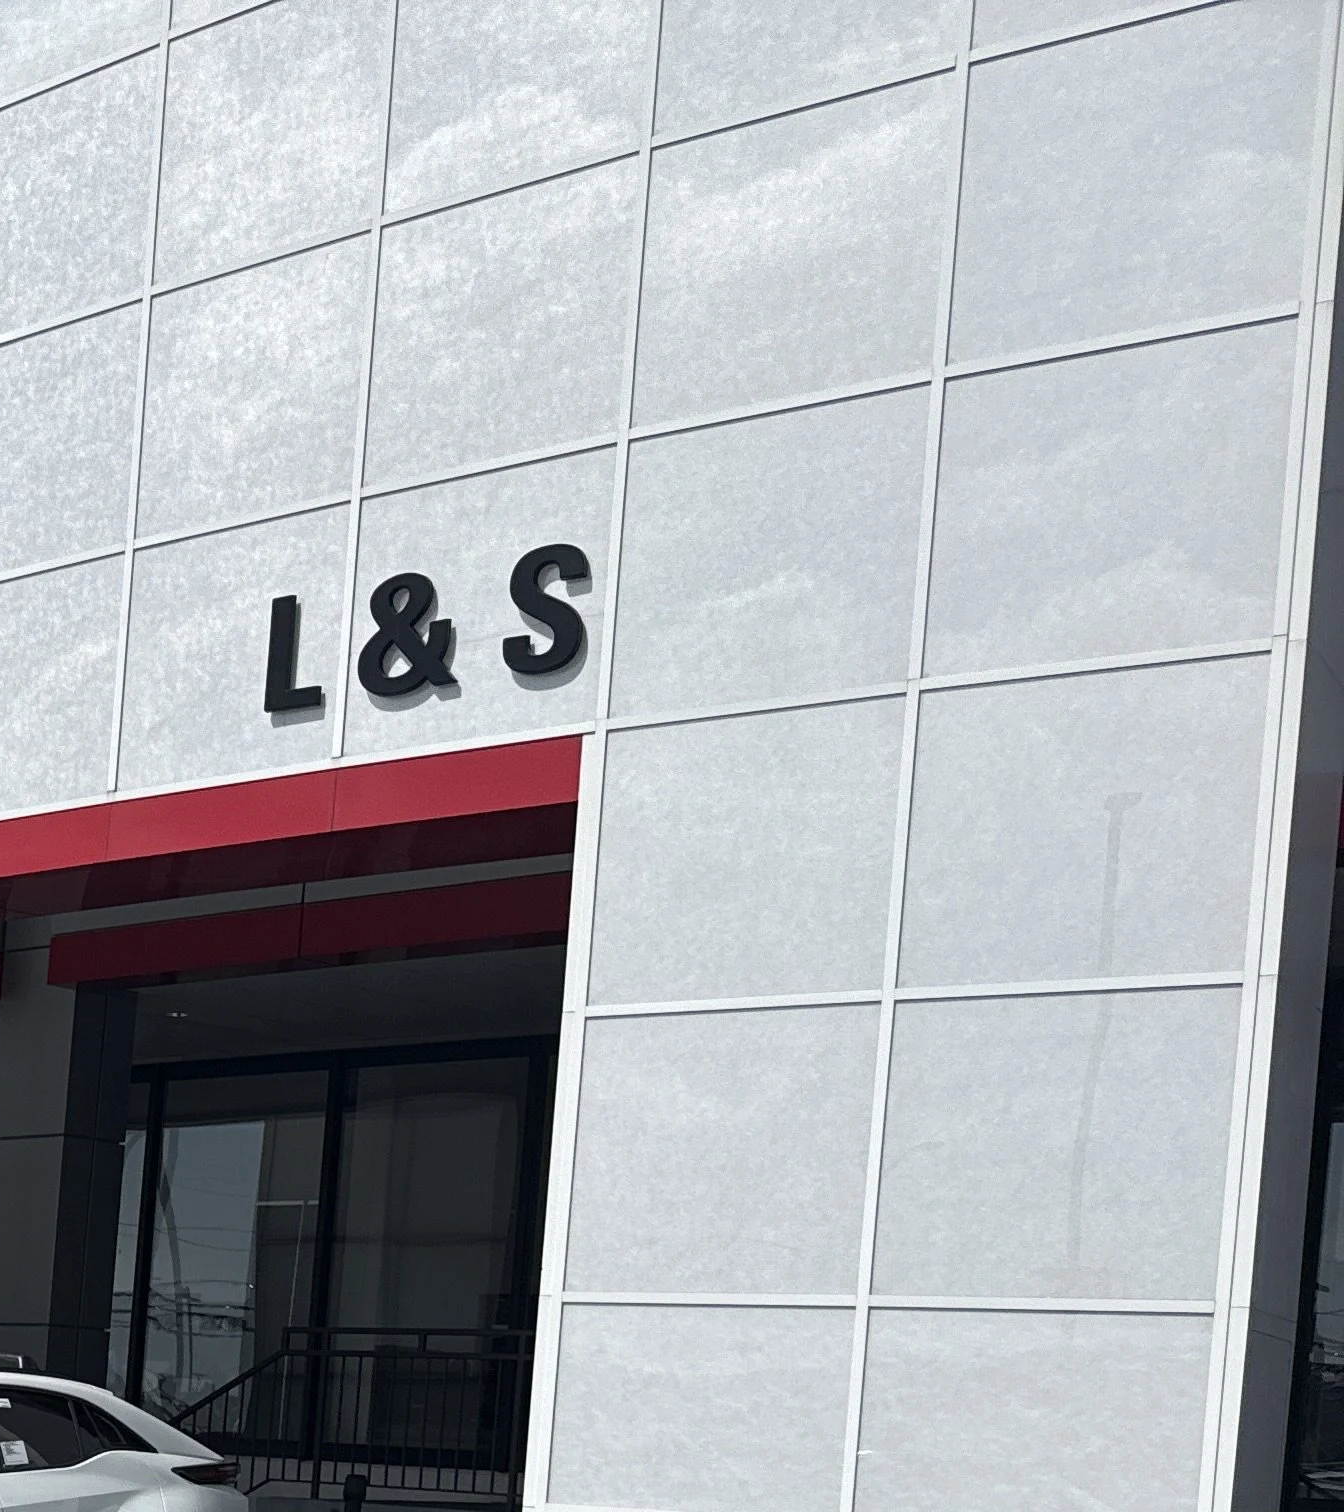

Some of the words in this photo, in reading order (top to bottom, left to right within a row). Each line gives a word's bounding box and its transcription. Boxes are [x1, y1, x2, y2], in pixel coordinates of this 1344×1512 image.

[264, 594, 322, 713] L
[357, 572, 458, 697] &
[503, 543, 588, 675] S
